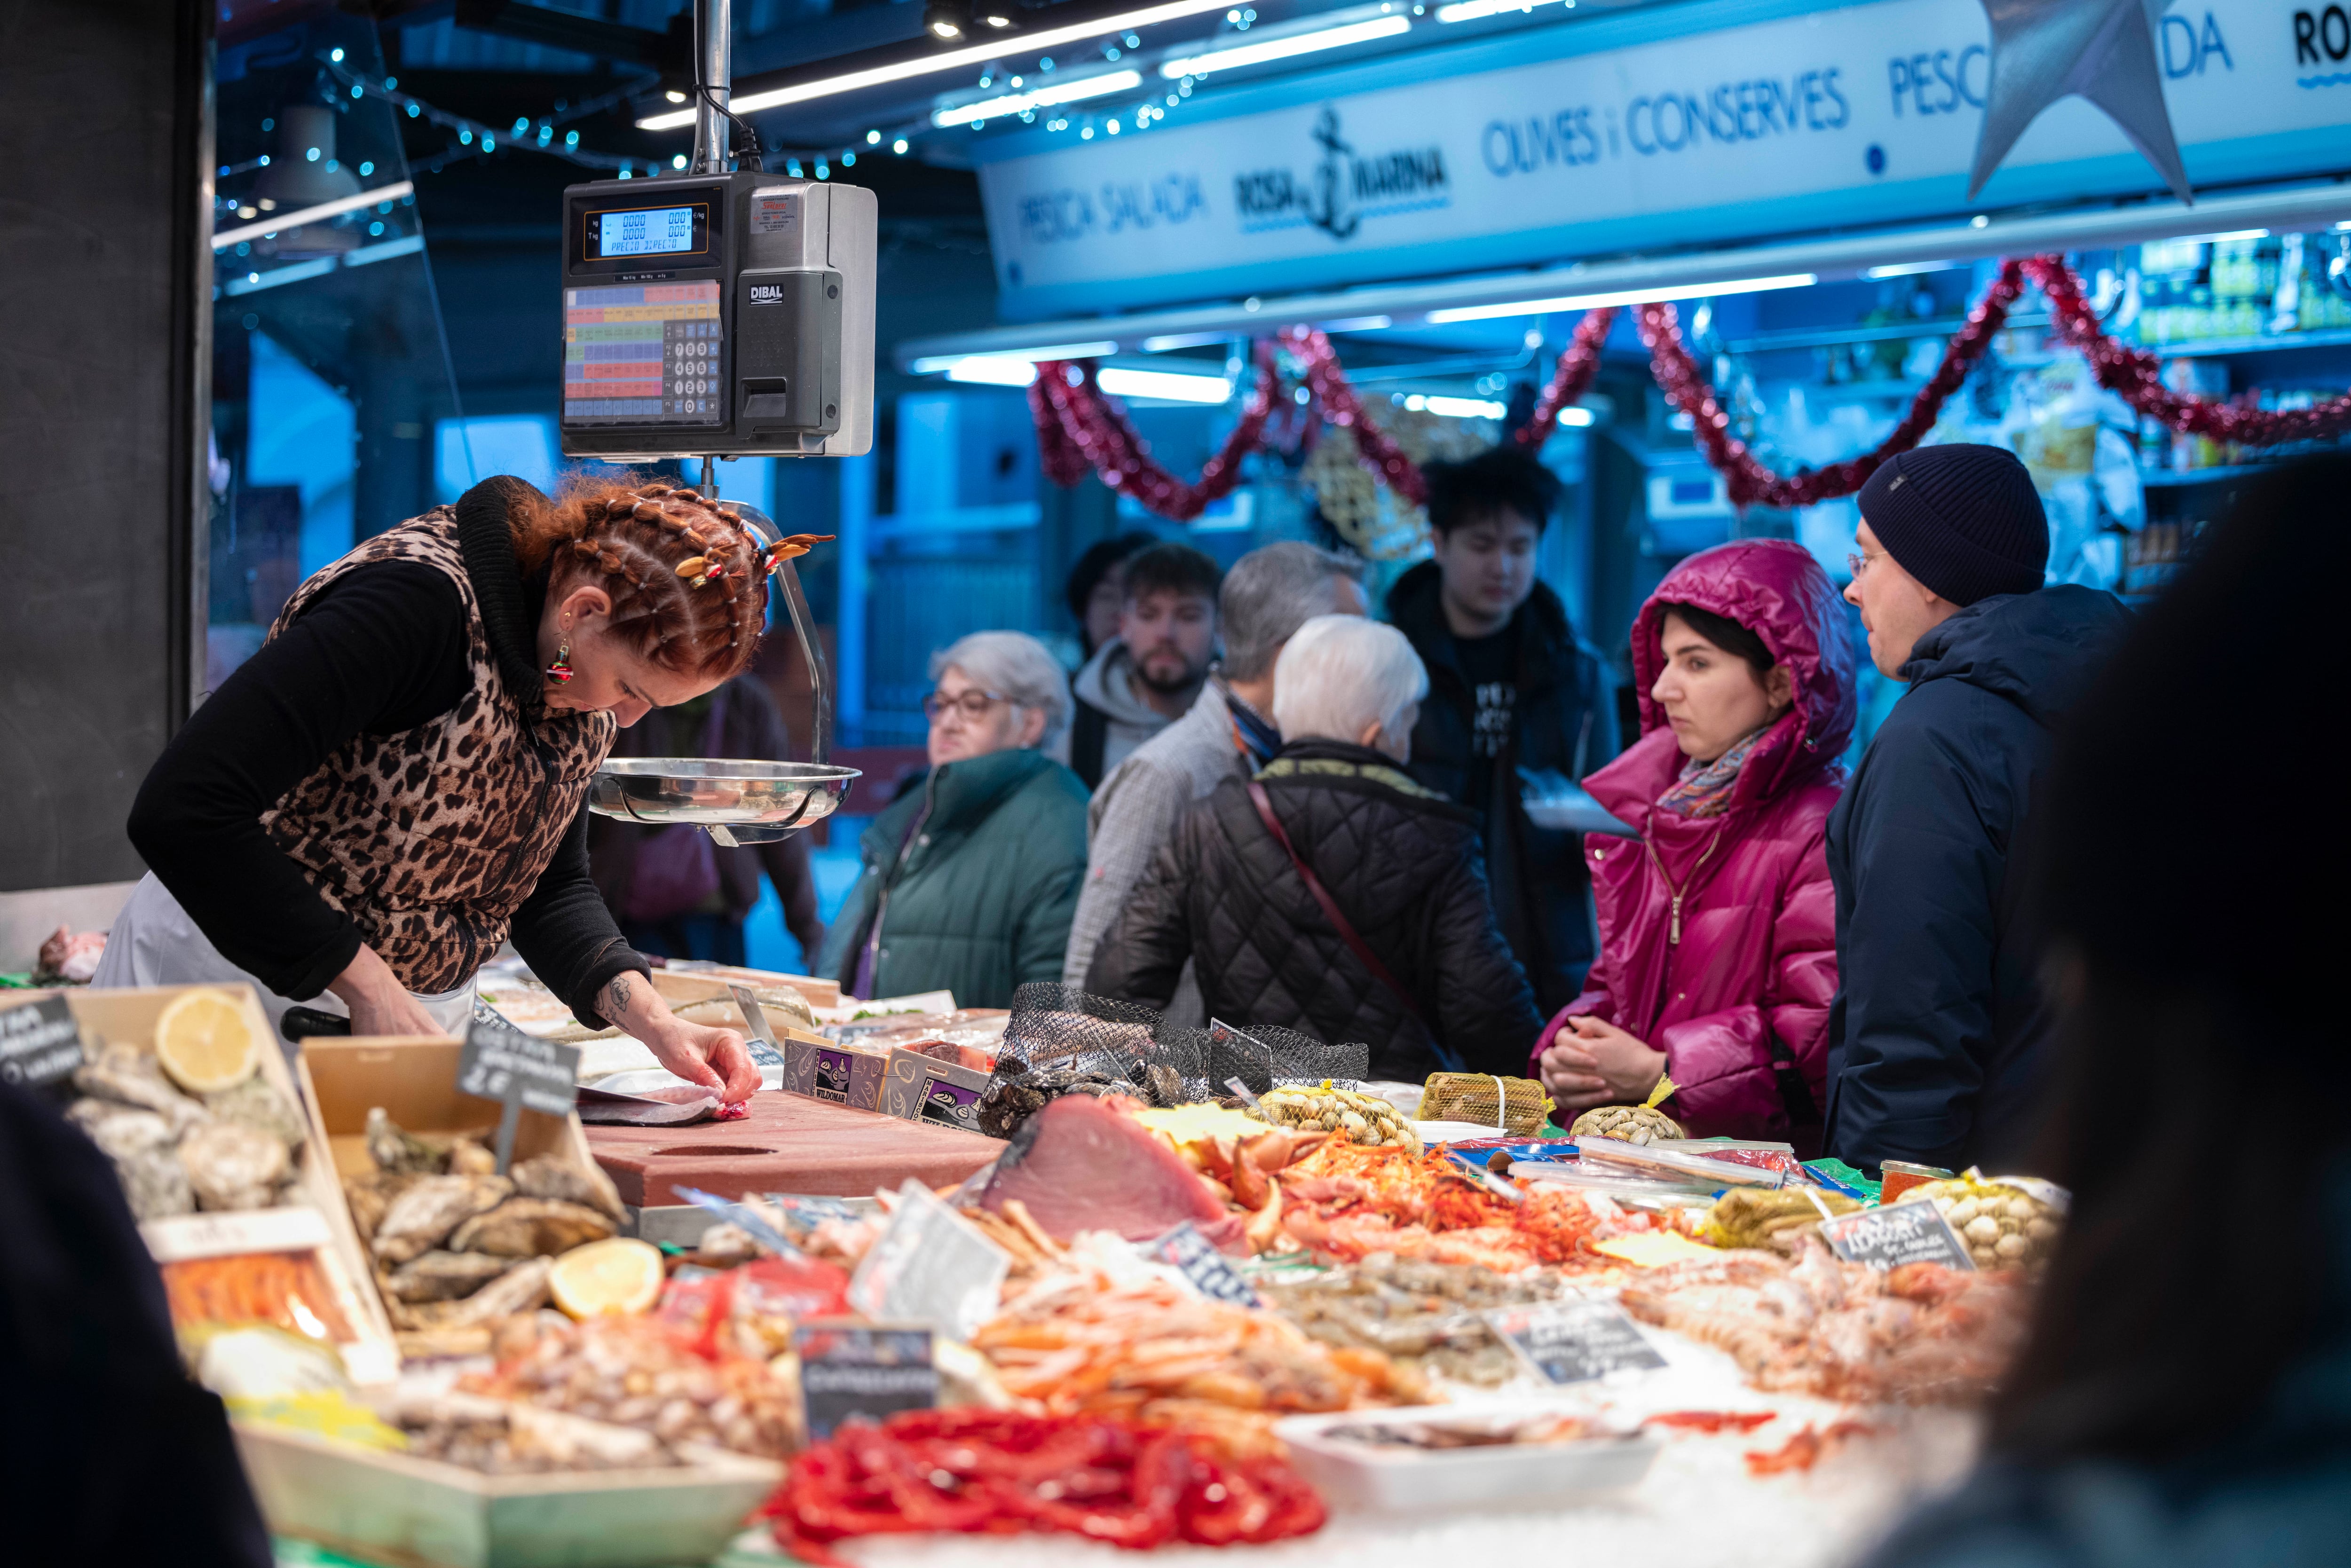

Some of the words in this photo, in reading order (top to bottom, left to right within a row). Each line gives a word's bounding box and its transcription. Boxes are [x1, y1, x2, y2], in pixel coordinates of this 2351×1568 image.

[2160, 8, 2234, 79] DA
[2292, 5, 2351, 66] RO
[1625, 67, 1851, 156] CONSERVES
[1887, 43, 1988, 119] PESC
[612, 241, 639, 252] PRECIO
[644, 239, 677, 250] DIRECTO
[751, 286, 782, 299] DIBAL
[817, 1088, 845, 1103] WILDOMAR
